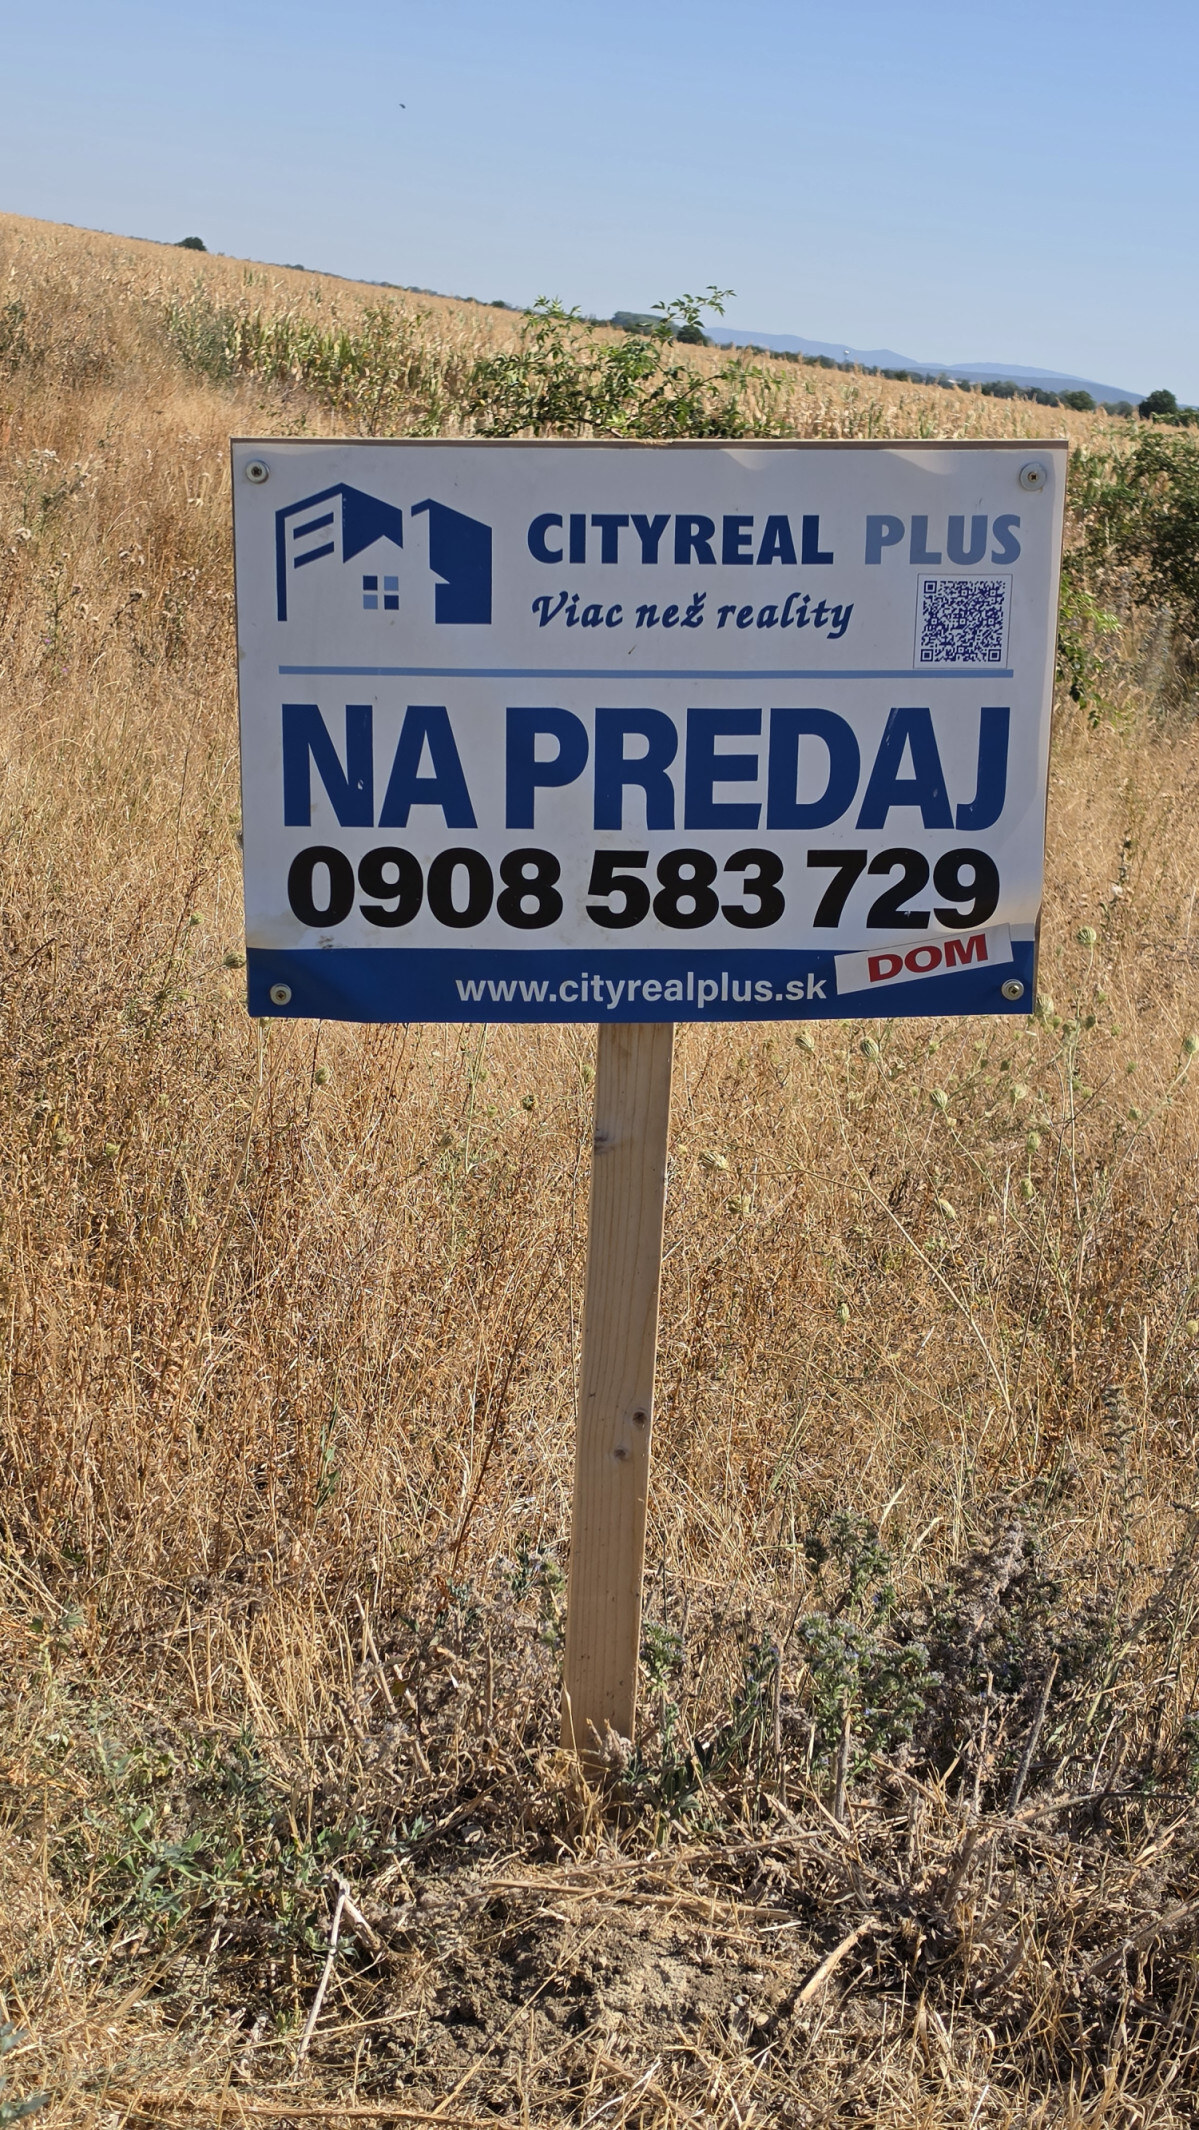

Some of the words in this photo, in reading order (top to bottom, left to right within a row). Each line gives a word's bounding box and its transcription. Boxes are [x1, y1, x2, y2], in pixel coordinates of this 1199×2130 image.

[527, 512, 834, 566] CITYREAL
[864, 513, 1022, 566] PLUS
[531, 590, 624, 629] Viac
[635, 591, 707, 629] než
[716, 591, 855, 640] reality
[281, 703, 479, 829] NA
[505, 706, 1011, 832] PREDAJ
[287, 845, 564, 930] 0908
[585, 847, 786, 930] 583
[806, 847, 1001, 930] 729
[867, 933, 989, 983] DOM
[455, 971, 827, 1010] www.cityrealplus.sk
